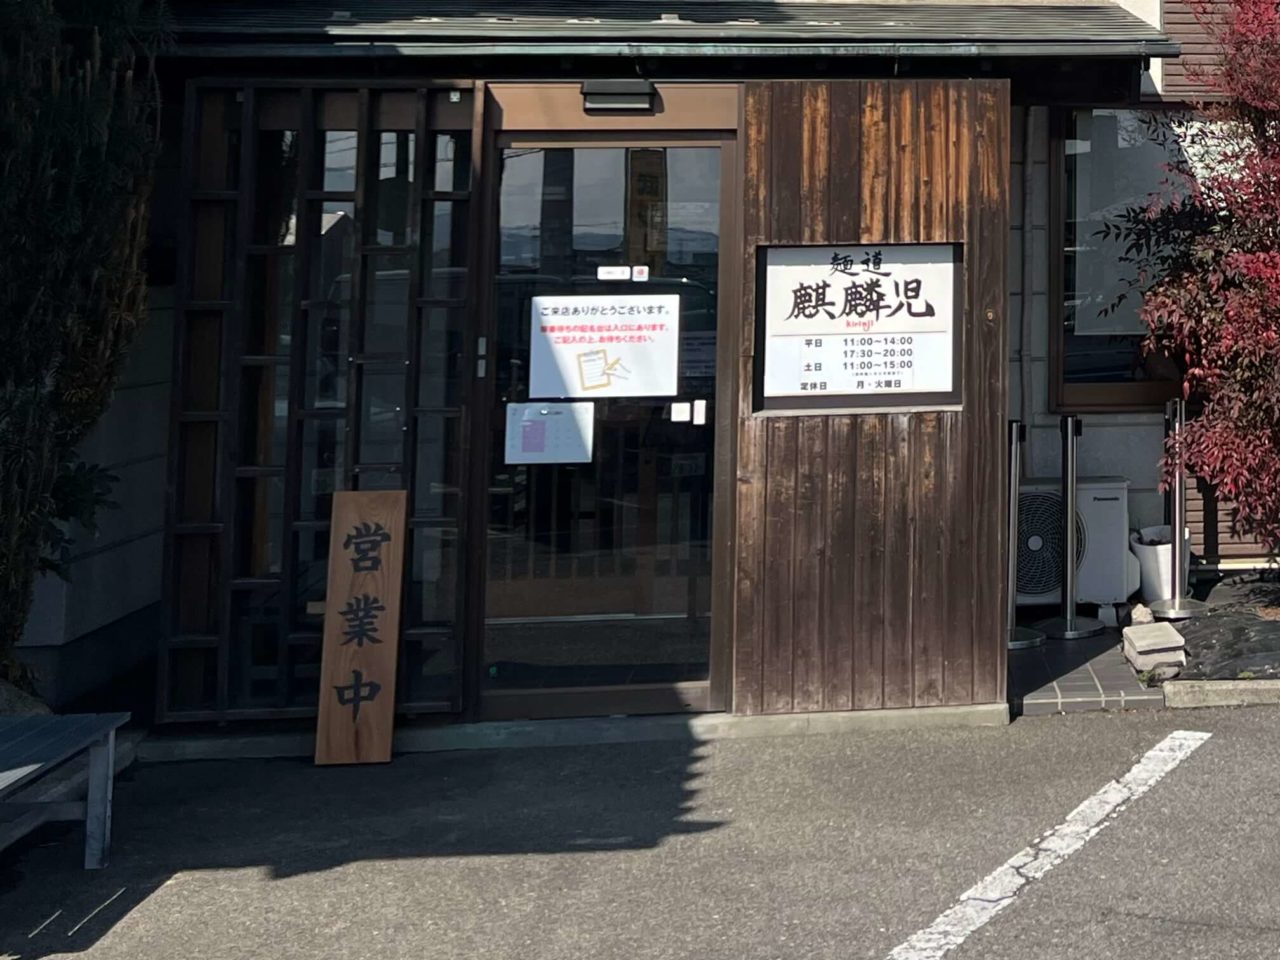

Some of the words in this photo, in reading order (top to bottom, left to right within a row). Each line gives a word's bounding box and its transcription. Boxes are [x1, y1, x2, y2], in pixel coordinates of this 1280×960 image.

[829, 249, 892, 277] 麺道
[784, 277, 936, 322] 麒麟児
[540, 304, 669, 317] ご来店ありがとうございます。
[804, 339, 823, 348] 平日
[803, 362, 823, 372] 土日
[799, 382, 828, 391] 定休日
[332, 521, 392, 724] 営業中
